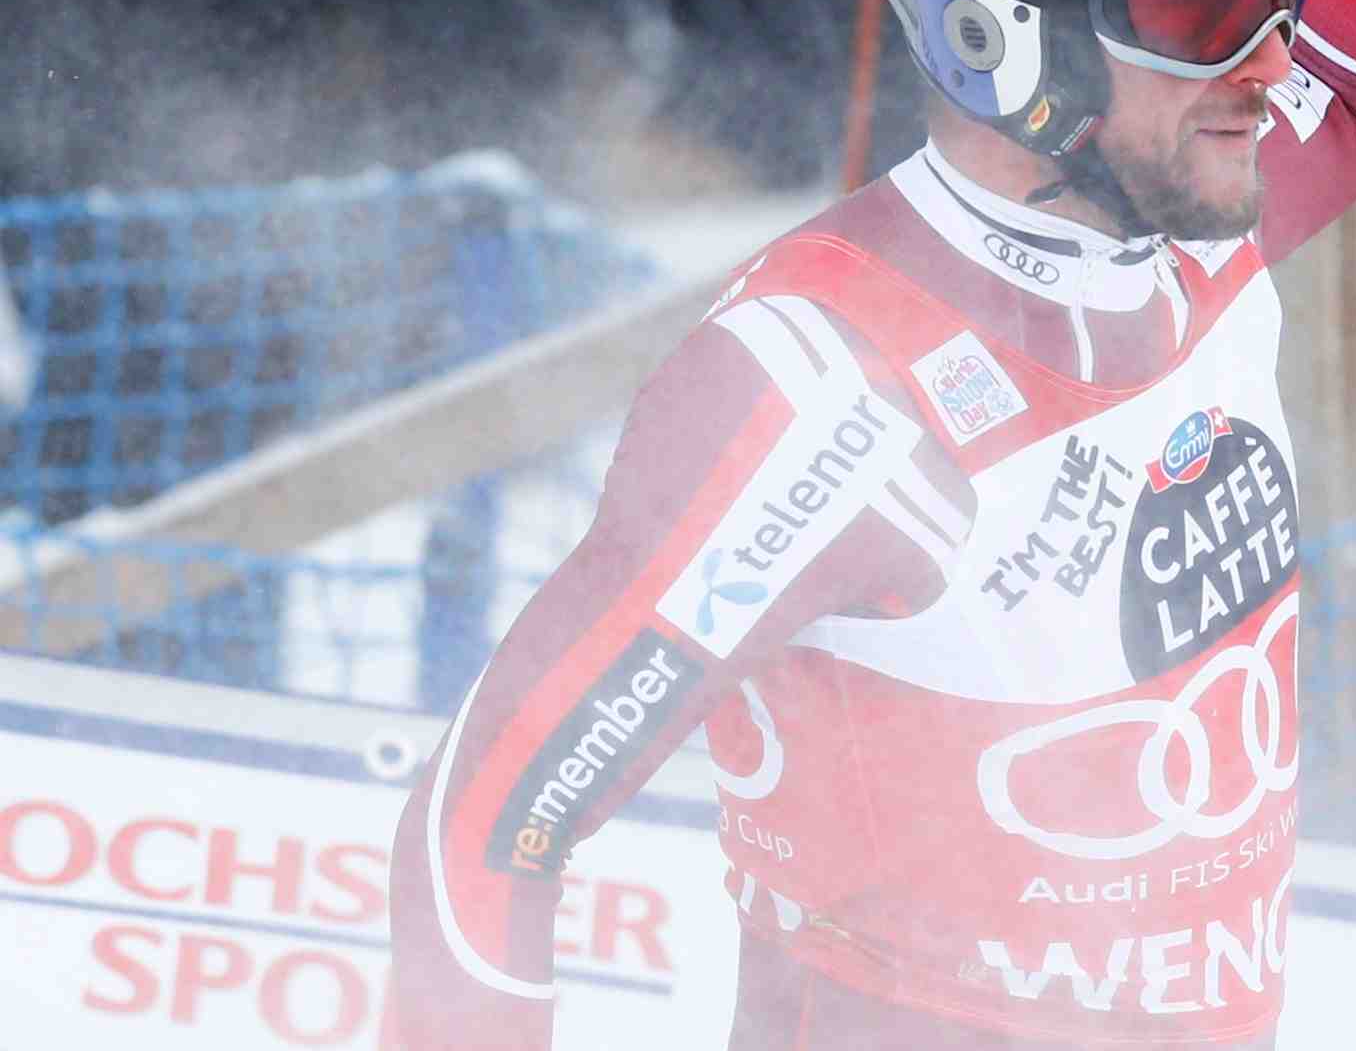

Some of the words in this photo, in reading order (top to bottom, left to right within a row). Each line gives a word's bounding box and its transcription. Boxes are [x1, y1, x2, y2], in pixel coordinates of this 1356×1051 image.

[733, 393, 888, 571] telenor
[1140, 436, 1283, 584] CAFFÈ
[1166, 420, 1210, 470] Emmi
[980, 531, 1060, 612] I'M
[1040, 434, 1099, 525] THE
[1053, 454, 1134, 598] BEST!
[1156, 508, 1296, 653] LATTE
[511, 647, 680, 871] re:member
[737, 814, 794, 862] Cup
[1017, 873, 1149, 904] Audi
[1169, 851, 1231, 895] FIS
[1237, 821, 1275, 869] Ski
